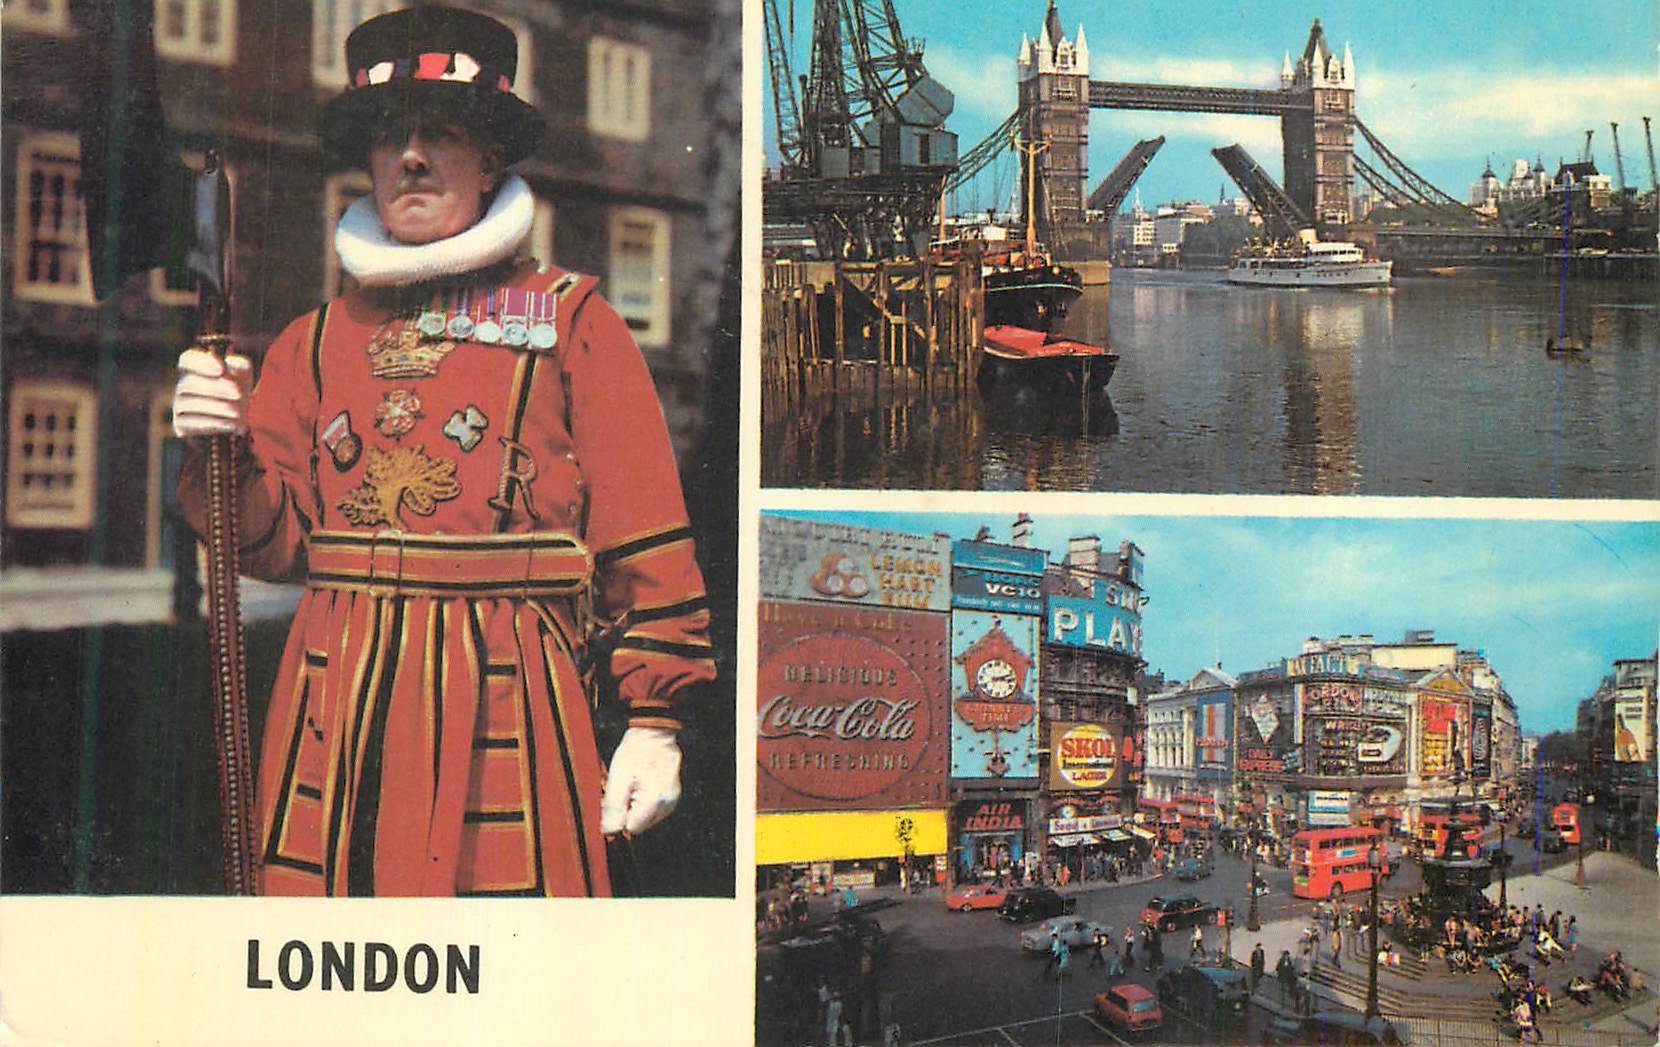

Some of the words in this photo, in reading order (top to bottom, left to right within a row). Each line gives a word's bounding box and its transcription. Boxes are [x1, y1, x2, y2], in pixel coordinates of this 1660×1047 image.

[870, 553, 941, 577] LEMON
[880, 573, 935, 593] HART
[985, 583, 1041, 599] VC10
[784, 663, 897, 687] DELICIOUS
[757, 694, 921, 741] Coca-Cola
[1061, 737, 1116, 758] SKOL
[768, 751, 910, 770] REFRESHING
[1072, 770, 1108, 781] LAGER
[975, 802, 1012, 815] AIR
[963, 815, 1023, 832] INDIA
